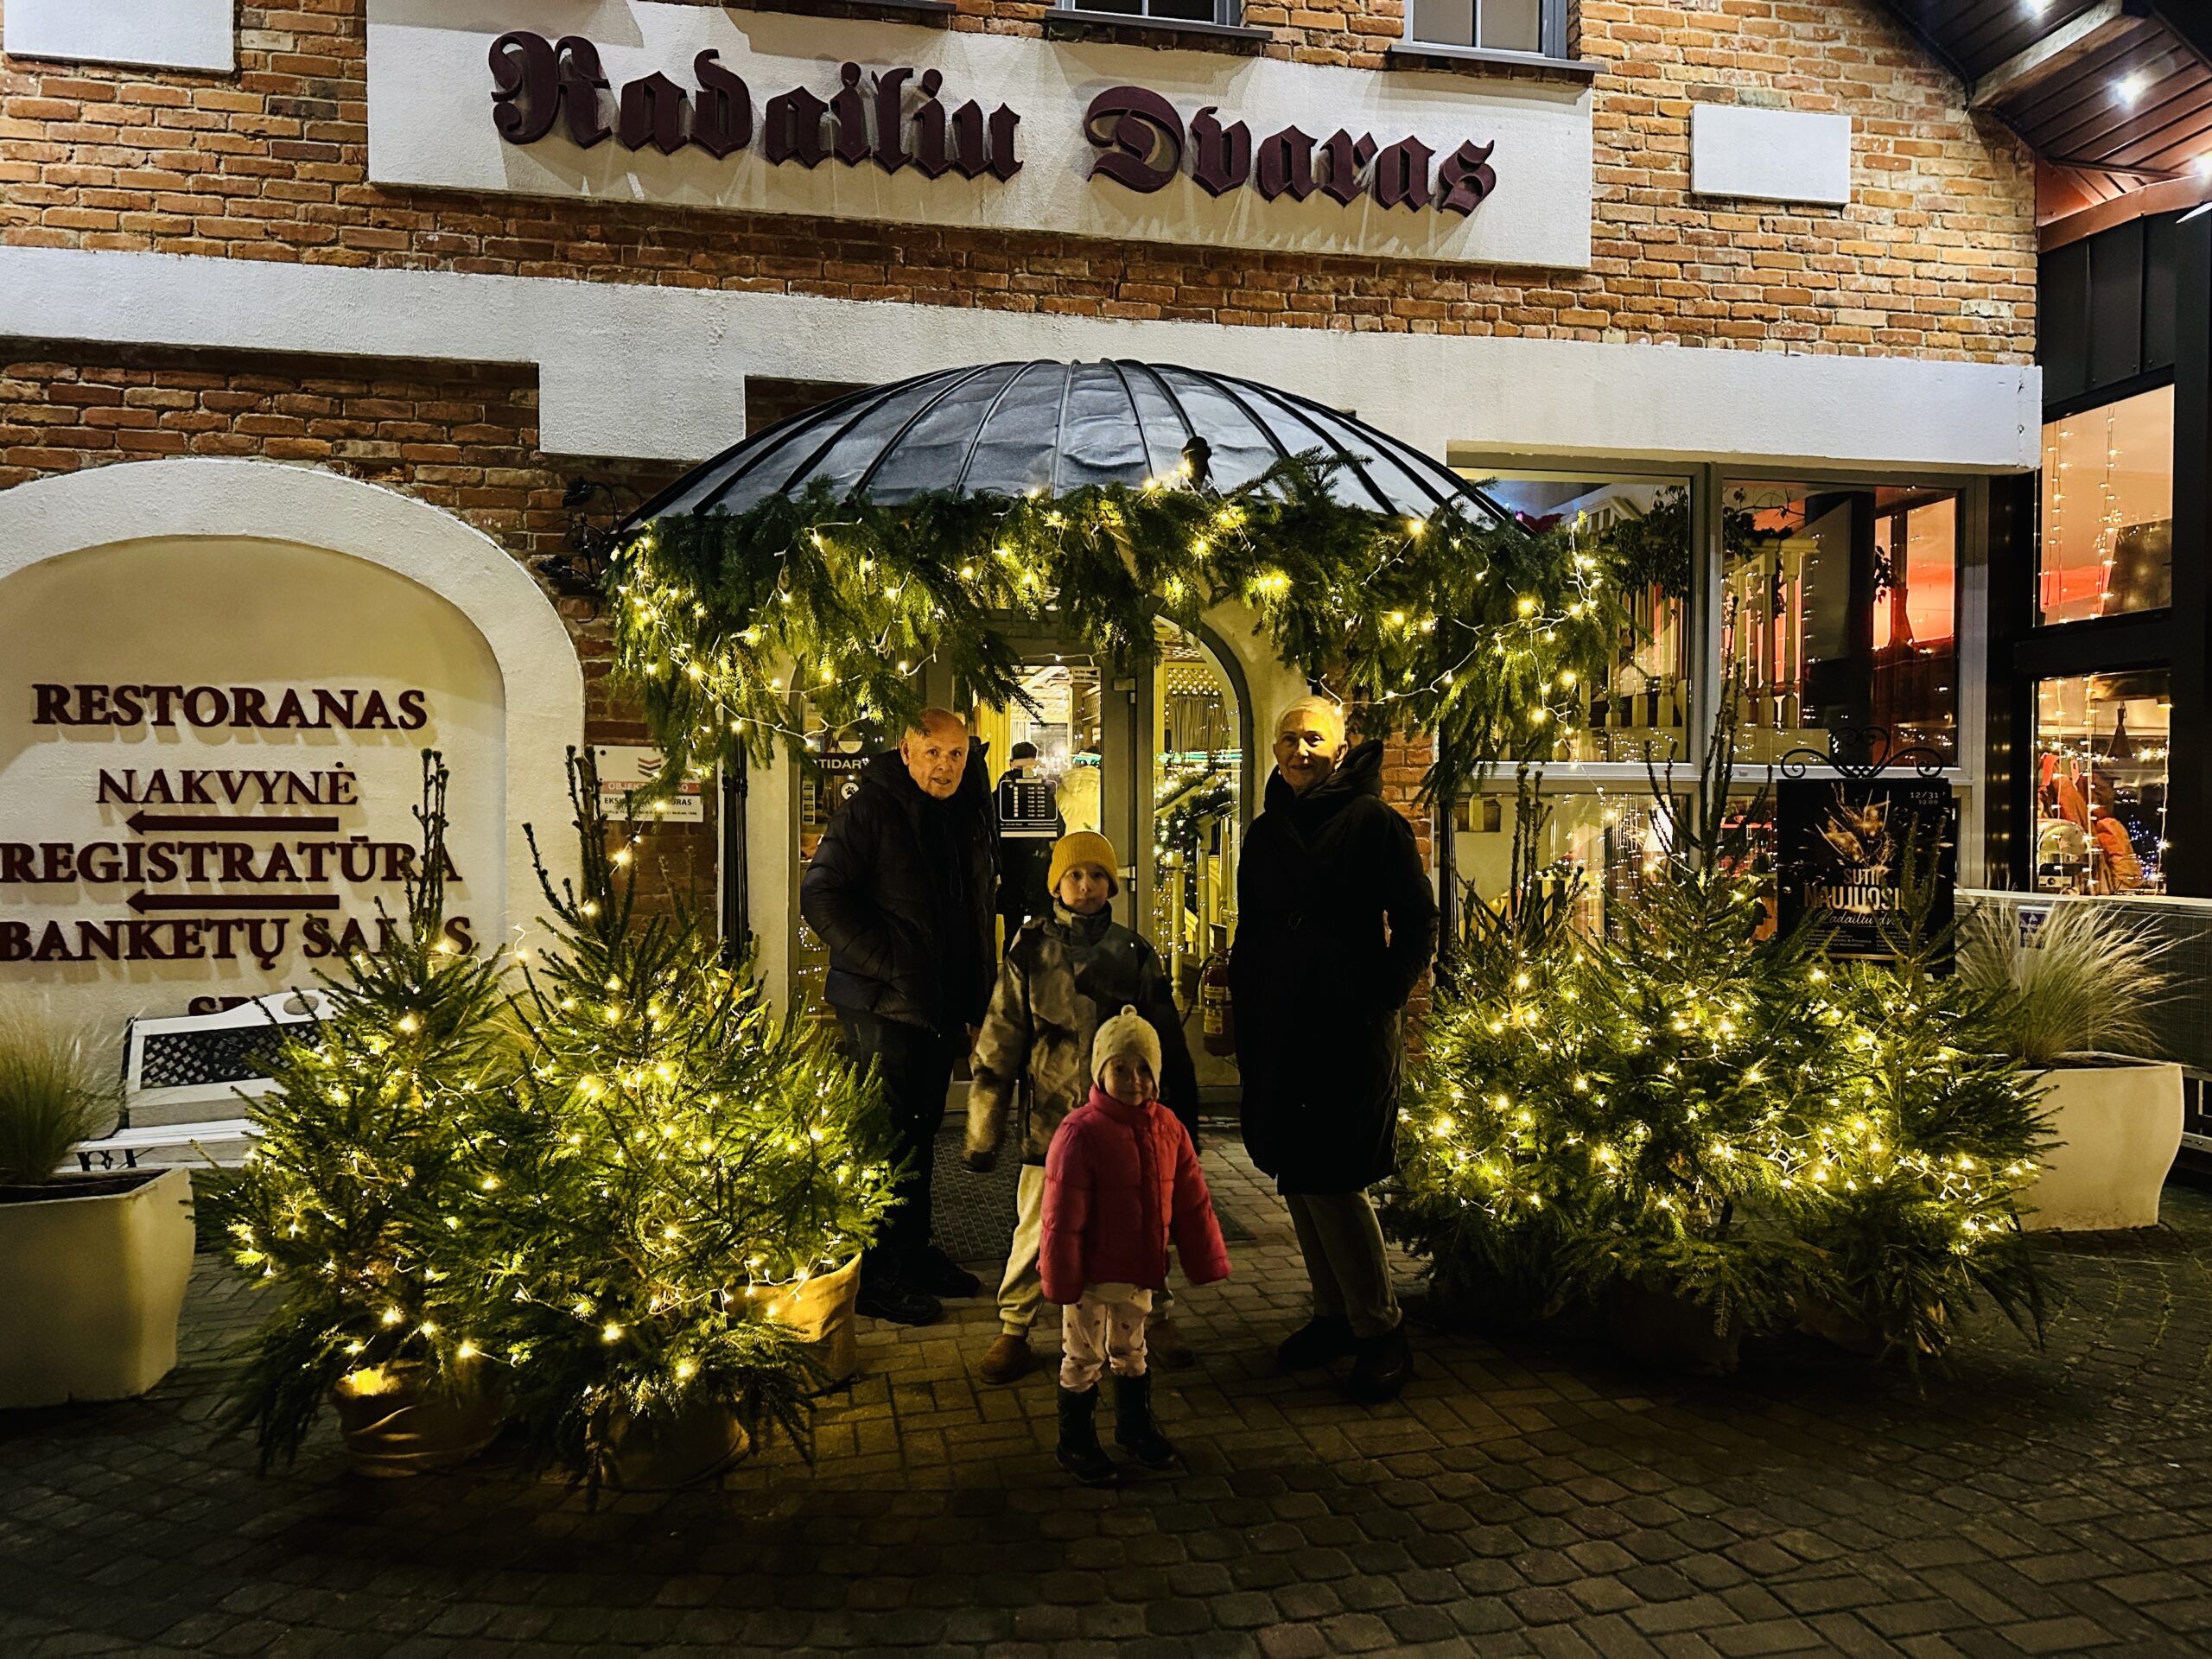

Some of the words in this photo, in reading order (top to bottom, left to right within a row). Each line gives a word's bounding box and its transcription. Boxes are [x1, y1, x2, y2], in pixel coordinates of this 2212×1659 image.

[1084, 86, 1497, 218] Dvaras
[32, 683, 428, 730] RESTORANAS
[96, 761, 359, 805] NAKVYNĖ
[813, 758, 869, 770] TIDAR
[1910, 791, 1939, 799] 12/31
[0, 836, 463, 883] REGISTRATŪRA
[1803, 884, 1906, 911] NAUJUOSI
[0, 918, 290, 970] BANKETŲ
[302, 916, 473, 958] SALS
